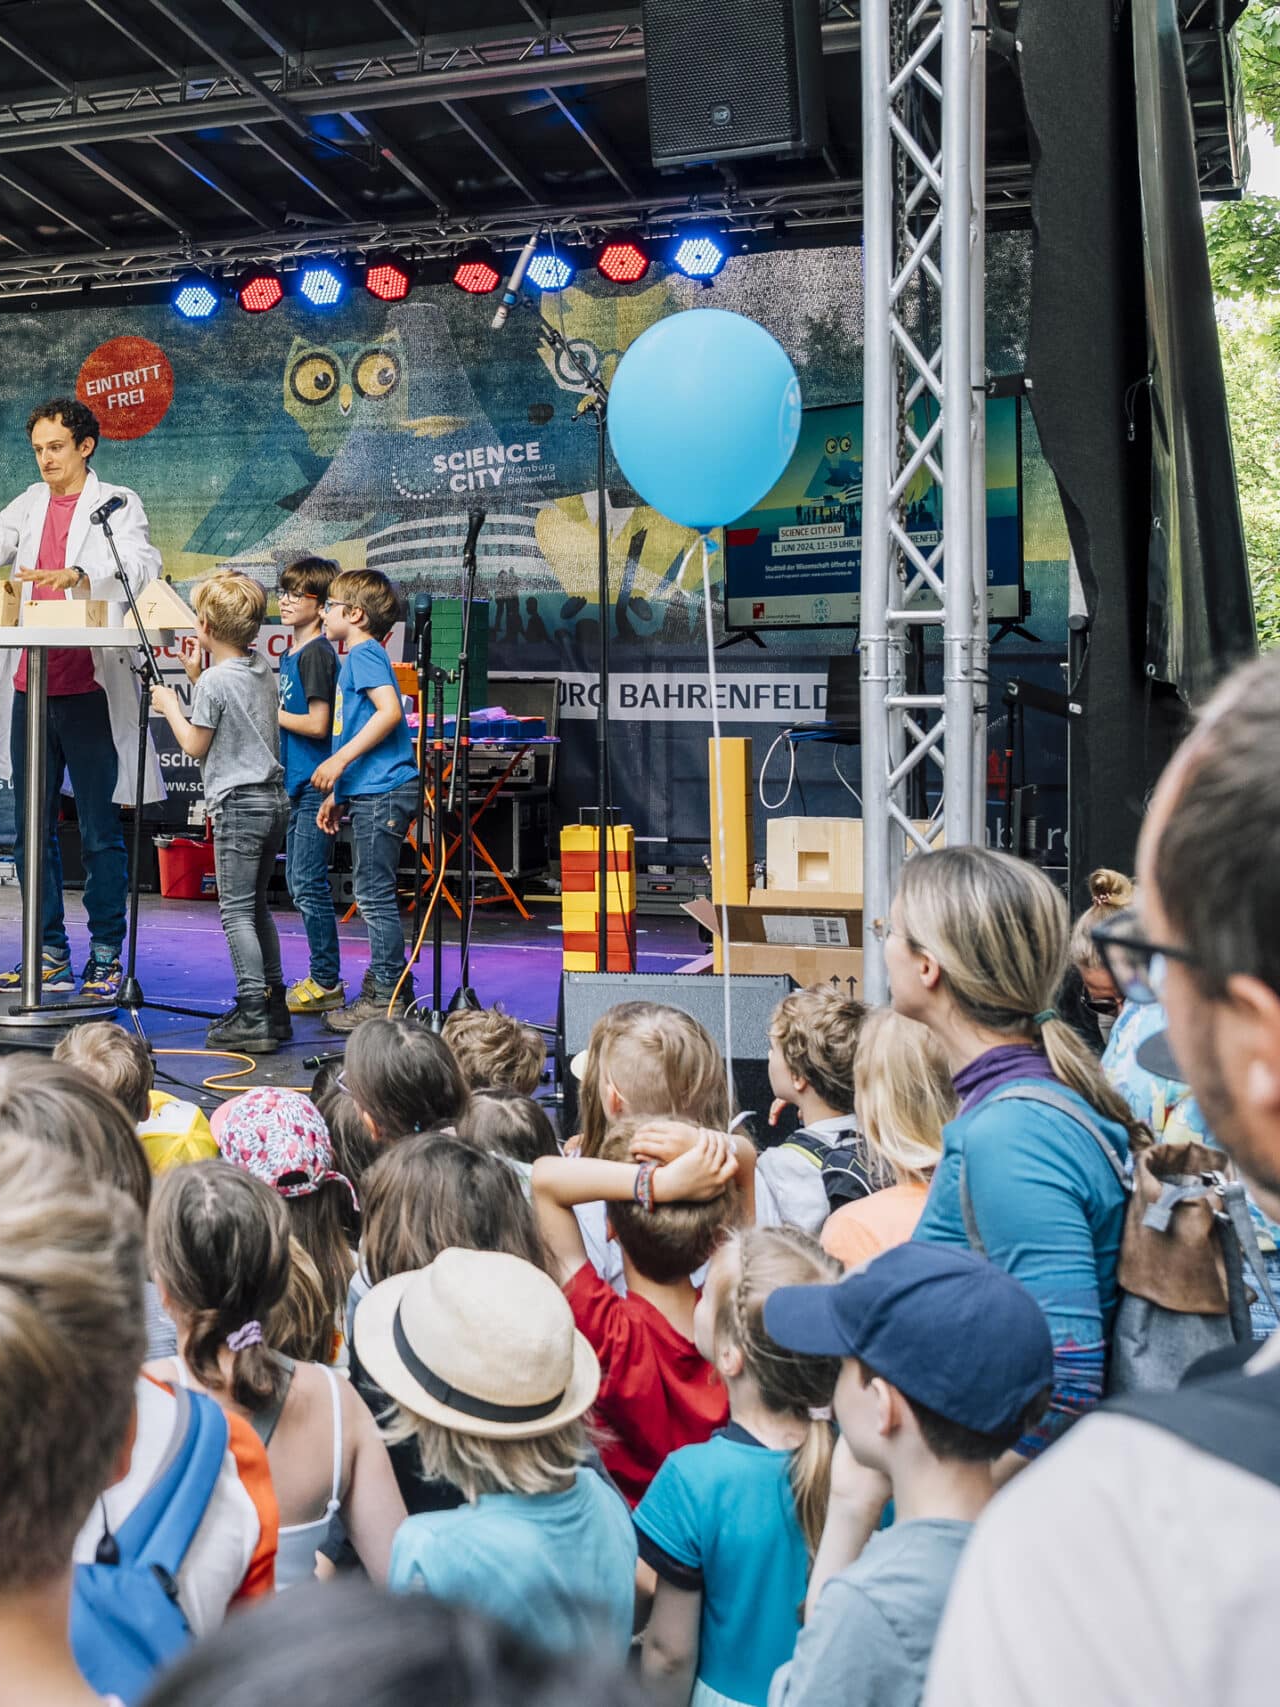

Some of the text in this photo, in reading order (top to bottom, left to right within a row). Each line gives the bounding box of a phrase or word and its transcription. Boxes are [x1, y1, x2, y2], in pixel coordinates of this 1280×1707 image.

[85, 364, 161, 396] EINTRITT
[107, 388, 145, 410] FREI
[433, 441, 541, 473] SCIENCE
[449, 467, 505, 492] CITY
[507, 463, 555, 474] Hamburg
[781, 524, 842, 538] SCIENCE CITY DAY
[781, 543, 795, 553] JUNI
[146, 602, 157, 619] 7
[619, 682, 828, 709] BAHRENFELD
